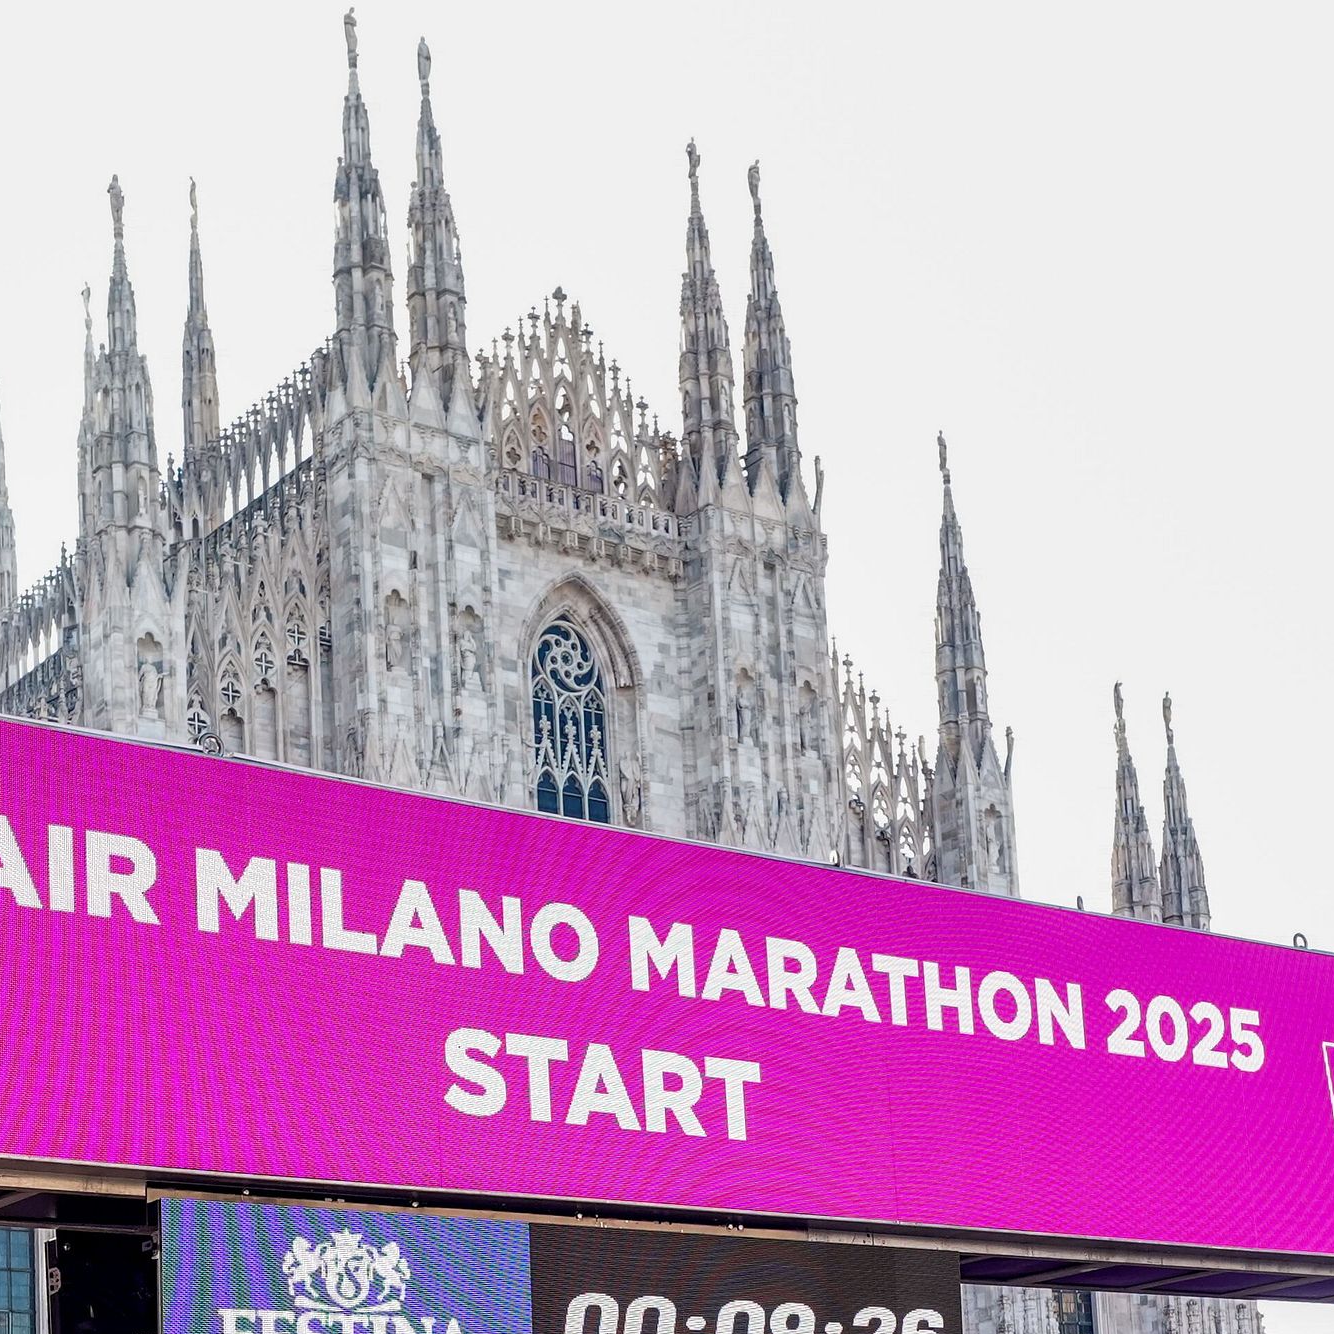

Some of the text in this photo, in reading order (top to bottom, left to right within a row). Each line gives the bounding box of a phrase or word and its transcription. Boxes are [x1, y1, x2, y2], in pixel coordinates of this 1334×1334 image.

[195, 848, 600, 983] MILANO
[628, 915, 1087, 1050] MARATHON
[1105, 989, 1266, 1073] 2025
[443, 1027, 762, 1141] START
